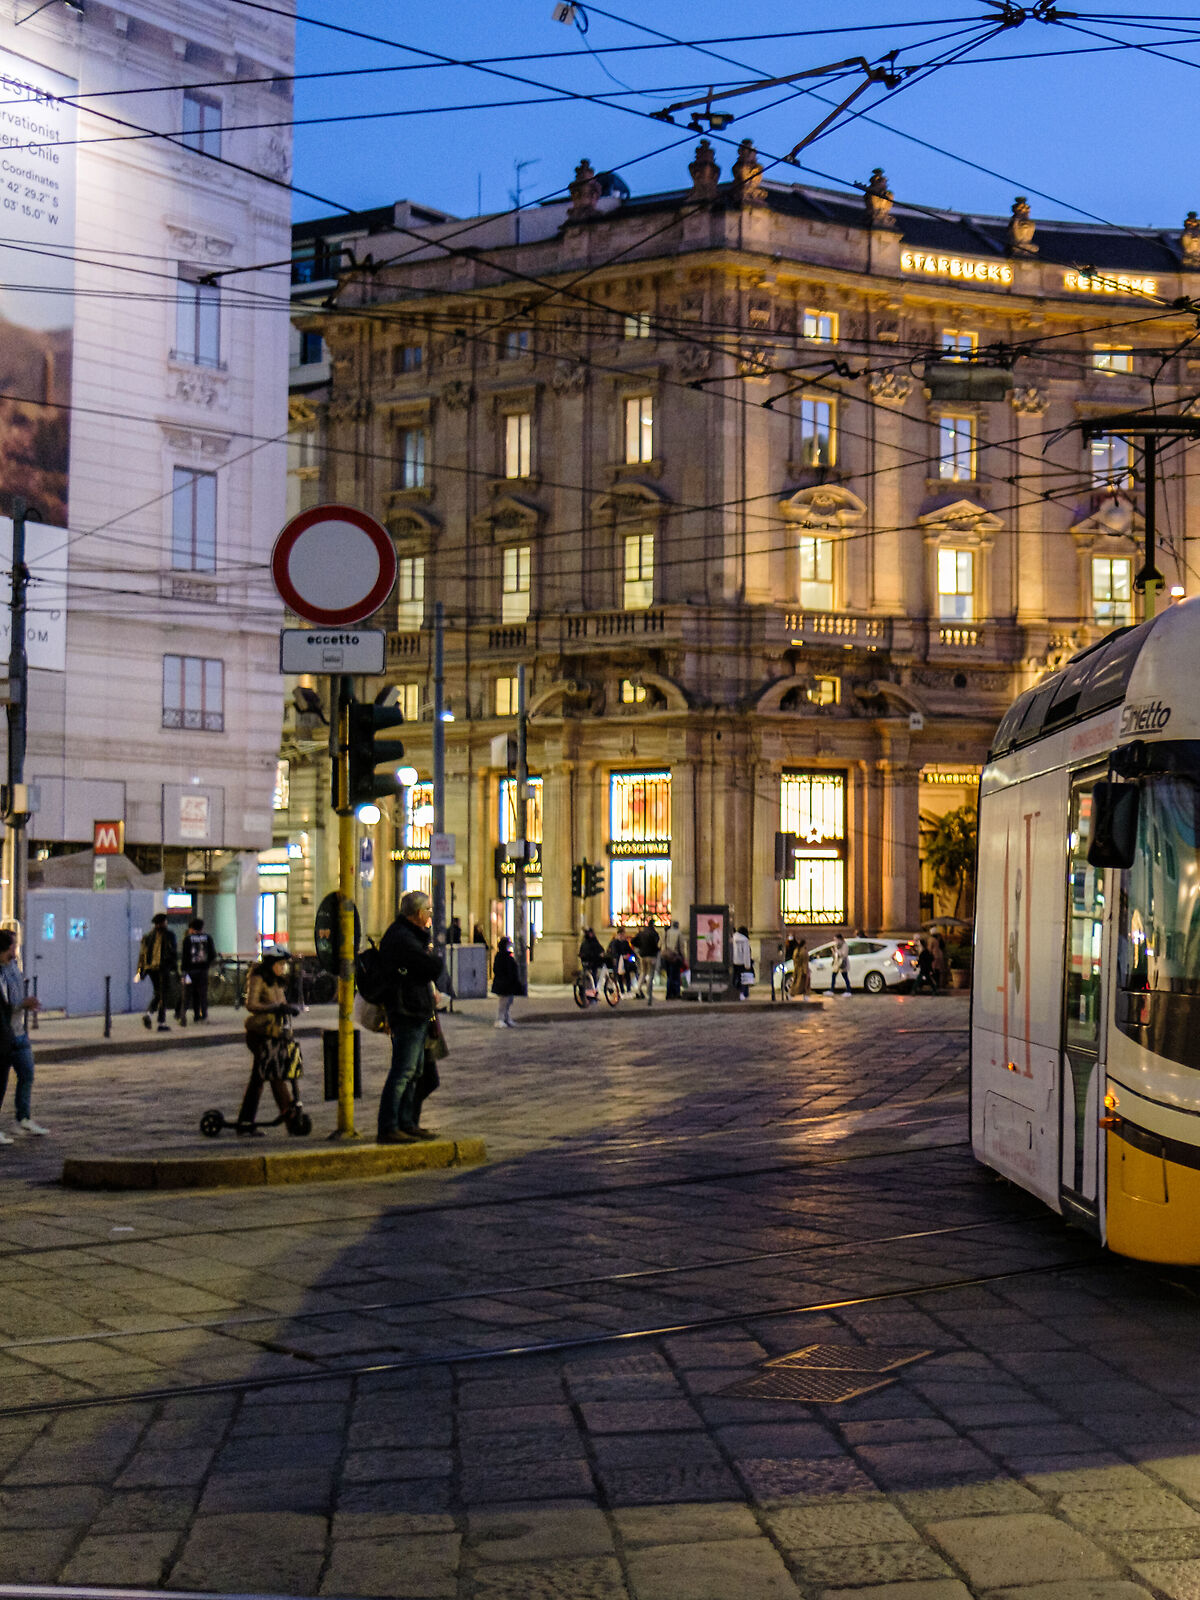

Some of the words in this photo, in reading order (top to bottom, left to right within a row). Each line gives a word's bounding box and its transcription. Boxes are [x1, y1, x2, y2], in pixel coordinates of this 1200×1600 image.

[0, 110, 59, 142] rvationist
[28, 141, 59, 164] Chile
[2, 160, 59, 190] Coordinates
[52, 196, 59, 208] S
[48, 213, 58, 225] W
[902, 253, 1013, 283] STARBUCKS
[307, 634, 359, 645] eccetto
[927, 773, 980, 784] STARBUCK
[96, 827, 118, 848] M
